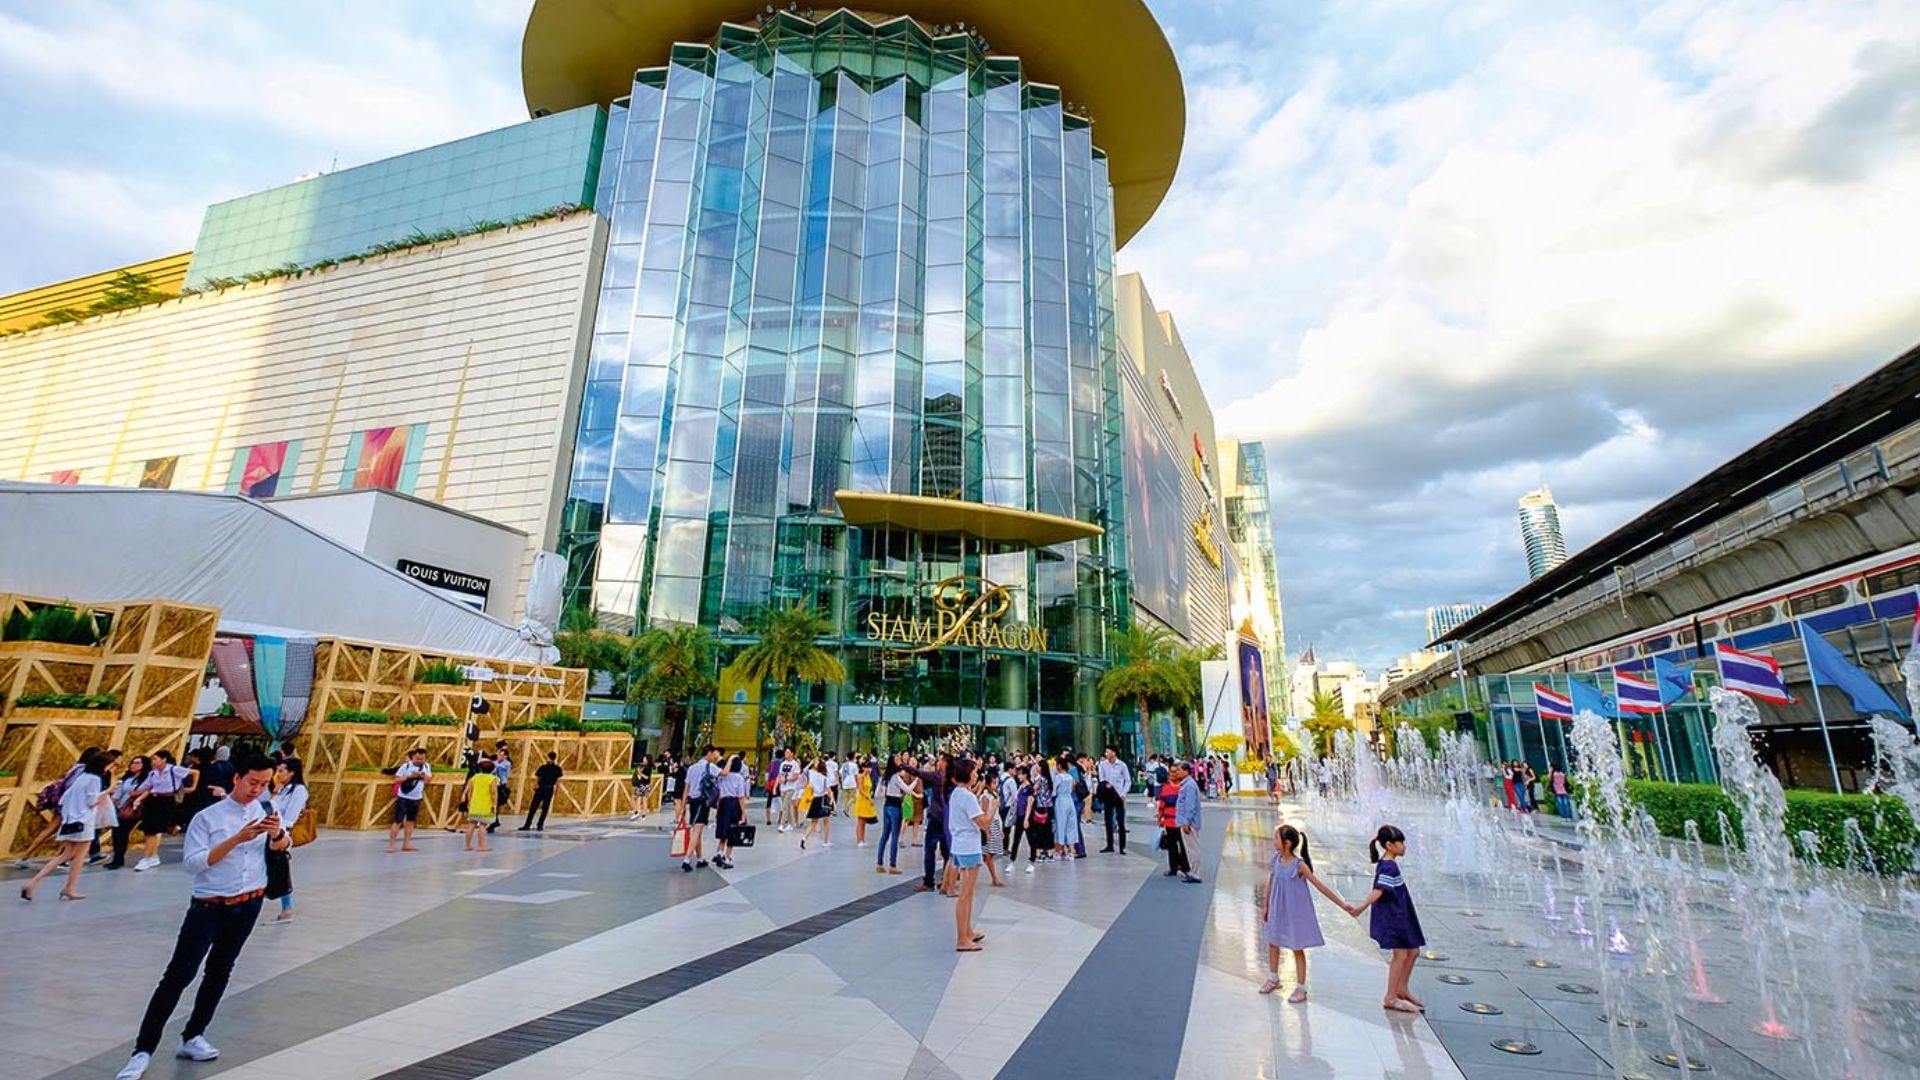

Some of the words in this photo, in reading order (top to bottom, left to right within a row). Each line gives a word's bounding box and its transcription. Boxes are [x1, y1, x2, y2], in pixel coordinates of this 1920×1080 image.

[405, 564, 439, 581] LOUIS
[443, 573, 487, 591] VUITTON
[867, 611, 932, 643] SIAM
[936, 609, 1047, 652] PARAGON
